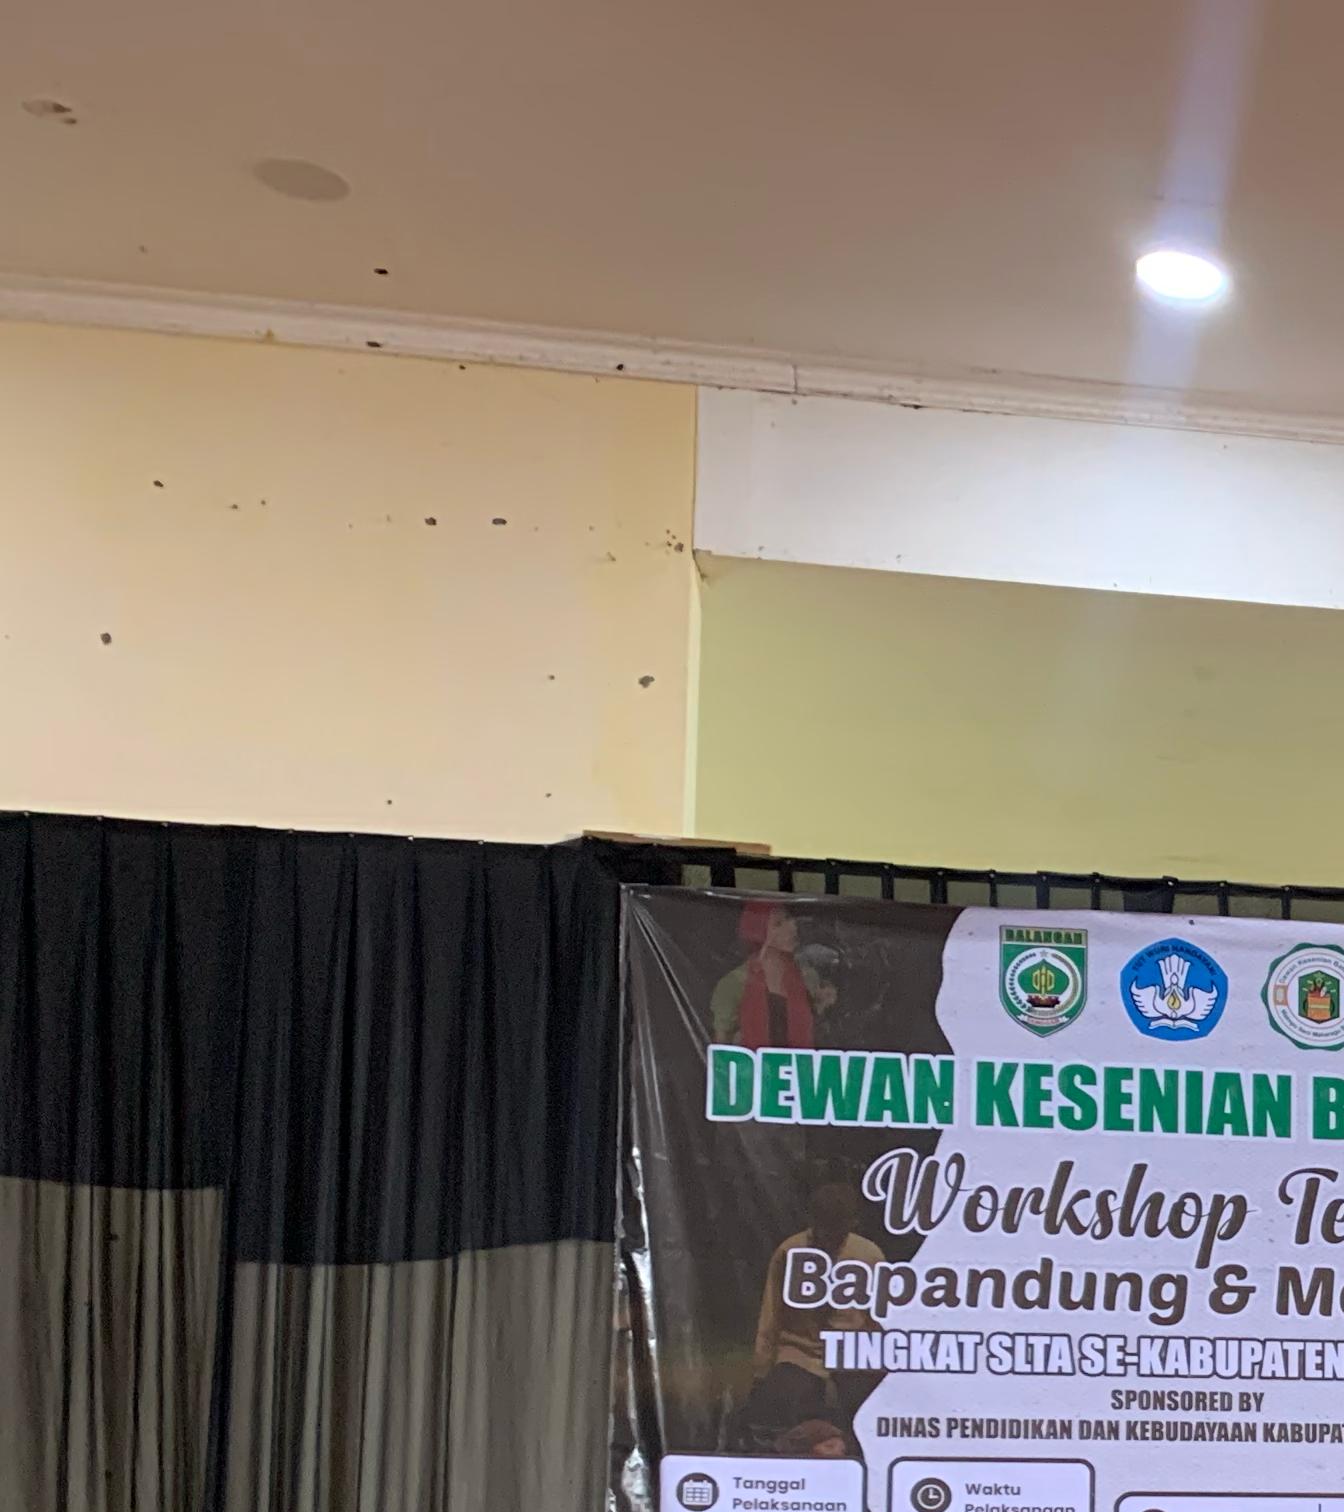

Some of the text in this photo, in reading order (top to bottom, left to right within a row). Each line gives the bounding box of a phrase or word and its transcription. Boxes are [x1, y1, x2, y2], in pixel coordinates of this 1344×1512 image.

[1005, 929, 1083, 945] BALANGAN
[709, 1047, 955, 1126] DEWAN
[975, 1061, 1292, 1138] KESENIAN
[866, 1150, 1256, 1269] Workshop
[786, 1251, 1189, 1326] Bapandung
[1209, 1264, 1256, 1315] &
[820, 1330, 983, 1373] TINGKAT
[987, 1332, 1075, 1377] SLTA
[1111, 1389, 1265, 1413] SPONSORED BY
[876, 1417, 941, 1438] DINAS
[946, 1418, 1073, 1441] PENDIDIKAN
[1078, 1420, 1120, 1441] DAN
[1125, 1421, 1257, 1443] KEBUDAYAAN
[733, 1477, 806, 1495] Tanggal
[965, 1483, 1021, 1496] Waktu
[732, 1497, 847, 1512] Pelaksanaan
